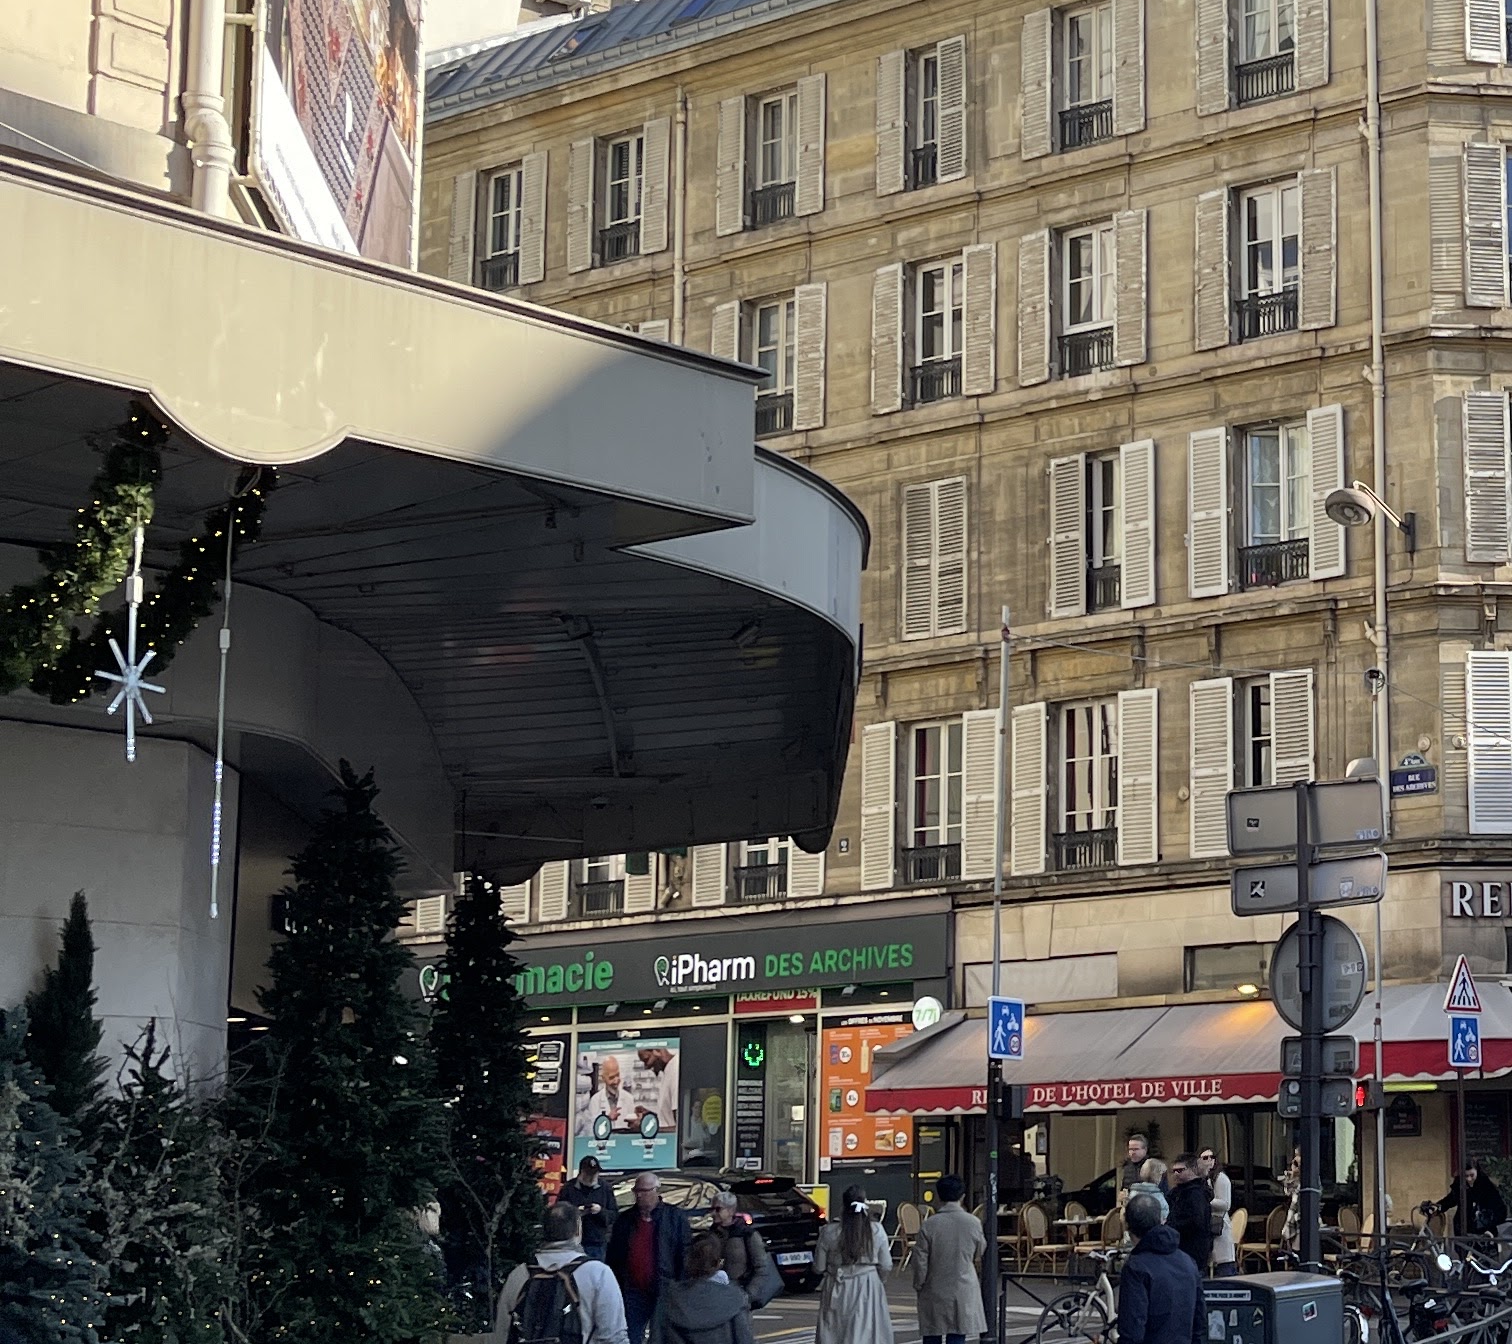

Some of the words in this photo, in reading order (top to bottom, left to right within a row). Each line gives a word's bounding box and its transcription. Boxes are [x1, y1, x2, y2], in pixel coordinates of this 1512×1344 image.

[1407, 773, 1421, 782] RUE
[1392, 785, 1405, 793] DES
[671, 953, 756, 986] iPharm
[764, 952, 804, 978] DES
[808, 942, 914, 975] ARCHIVES
[1032, 1086, 1057, 1103] DE
[1061, 1081, 1136, 1102] L'HOTEL
[1140, 1081, 1166, 1098] DE
[1169, 1078, 1224, 1097] VILLE
